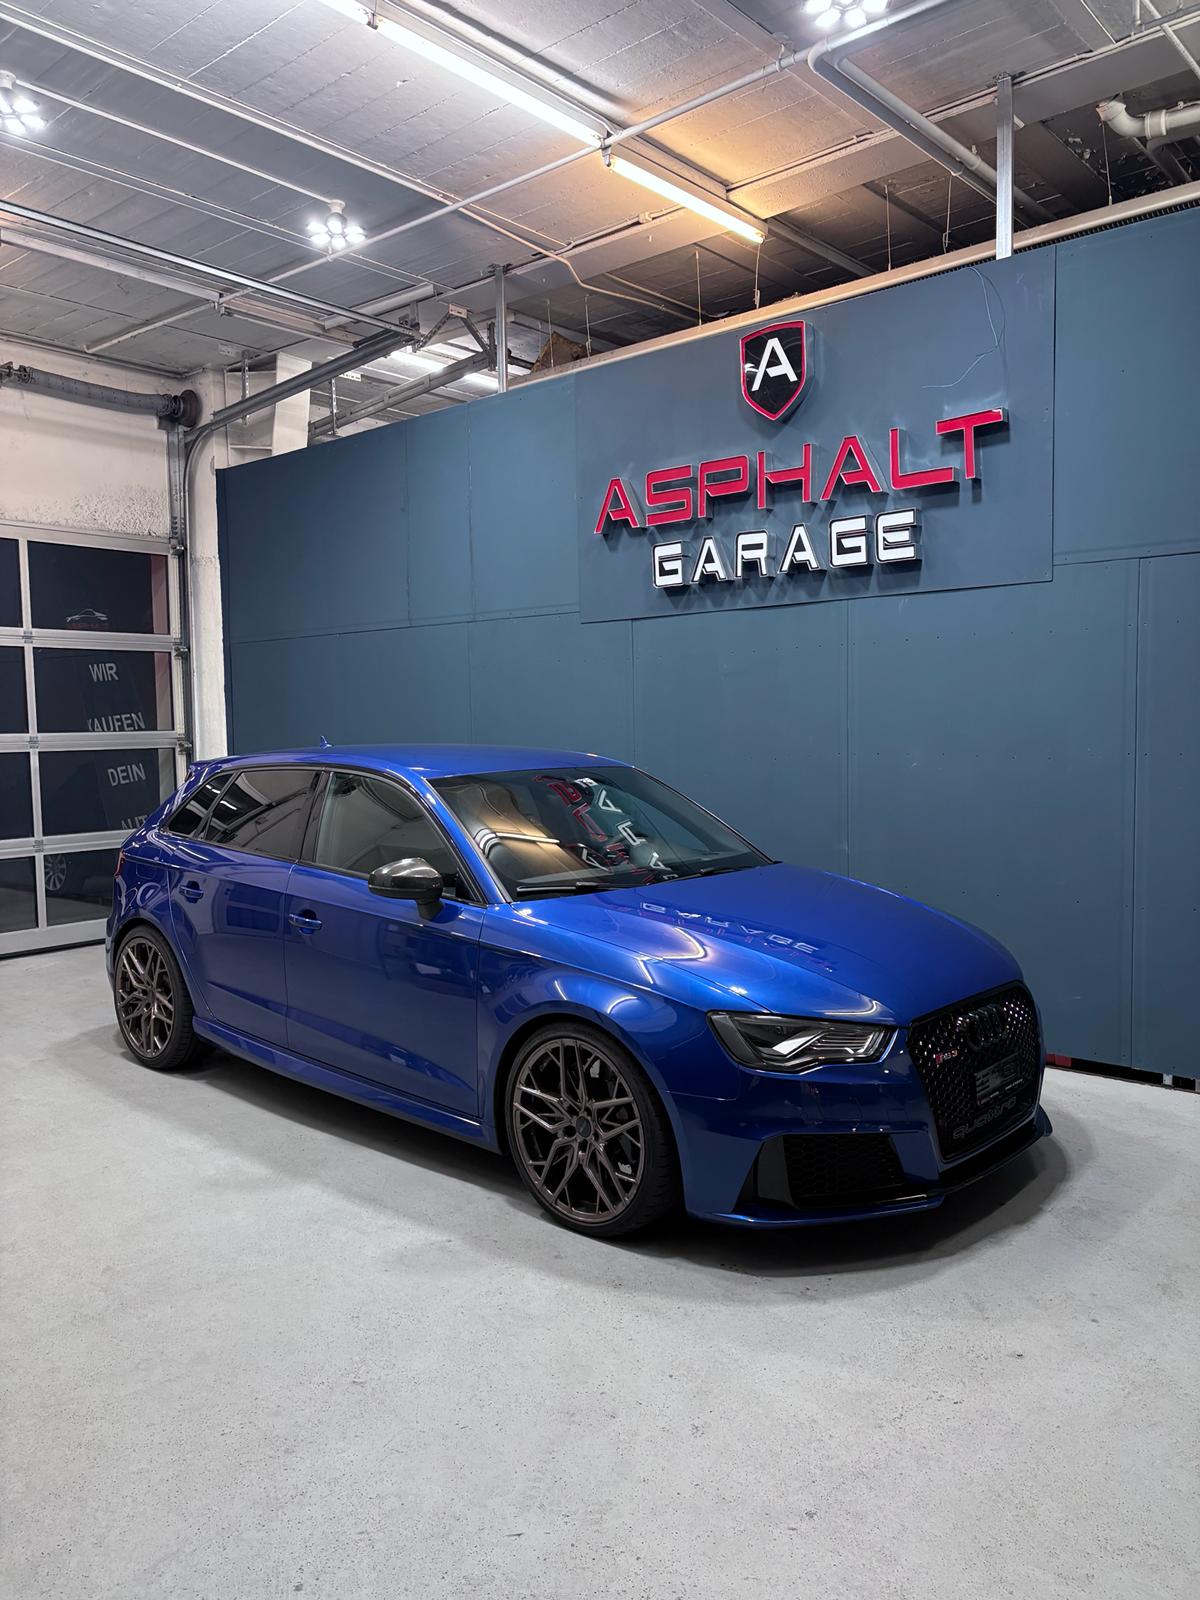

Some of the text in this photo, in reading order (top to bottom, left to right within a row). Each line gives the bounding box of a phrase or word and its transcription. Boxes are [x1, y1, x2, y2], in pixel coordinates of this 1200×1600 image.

[751, 337, 799, 392] A
[593, 407, 1007, 534] ASPHALT
[652, 508, 918, 589] GARAGE
[88, 662, 119, 683] WIR
[107, 762, 147, 787] DEIN
